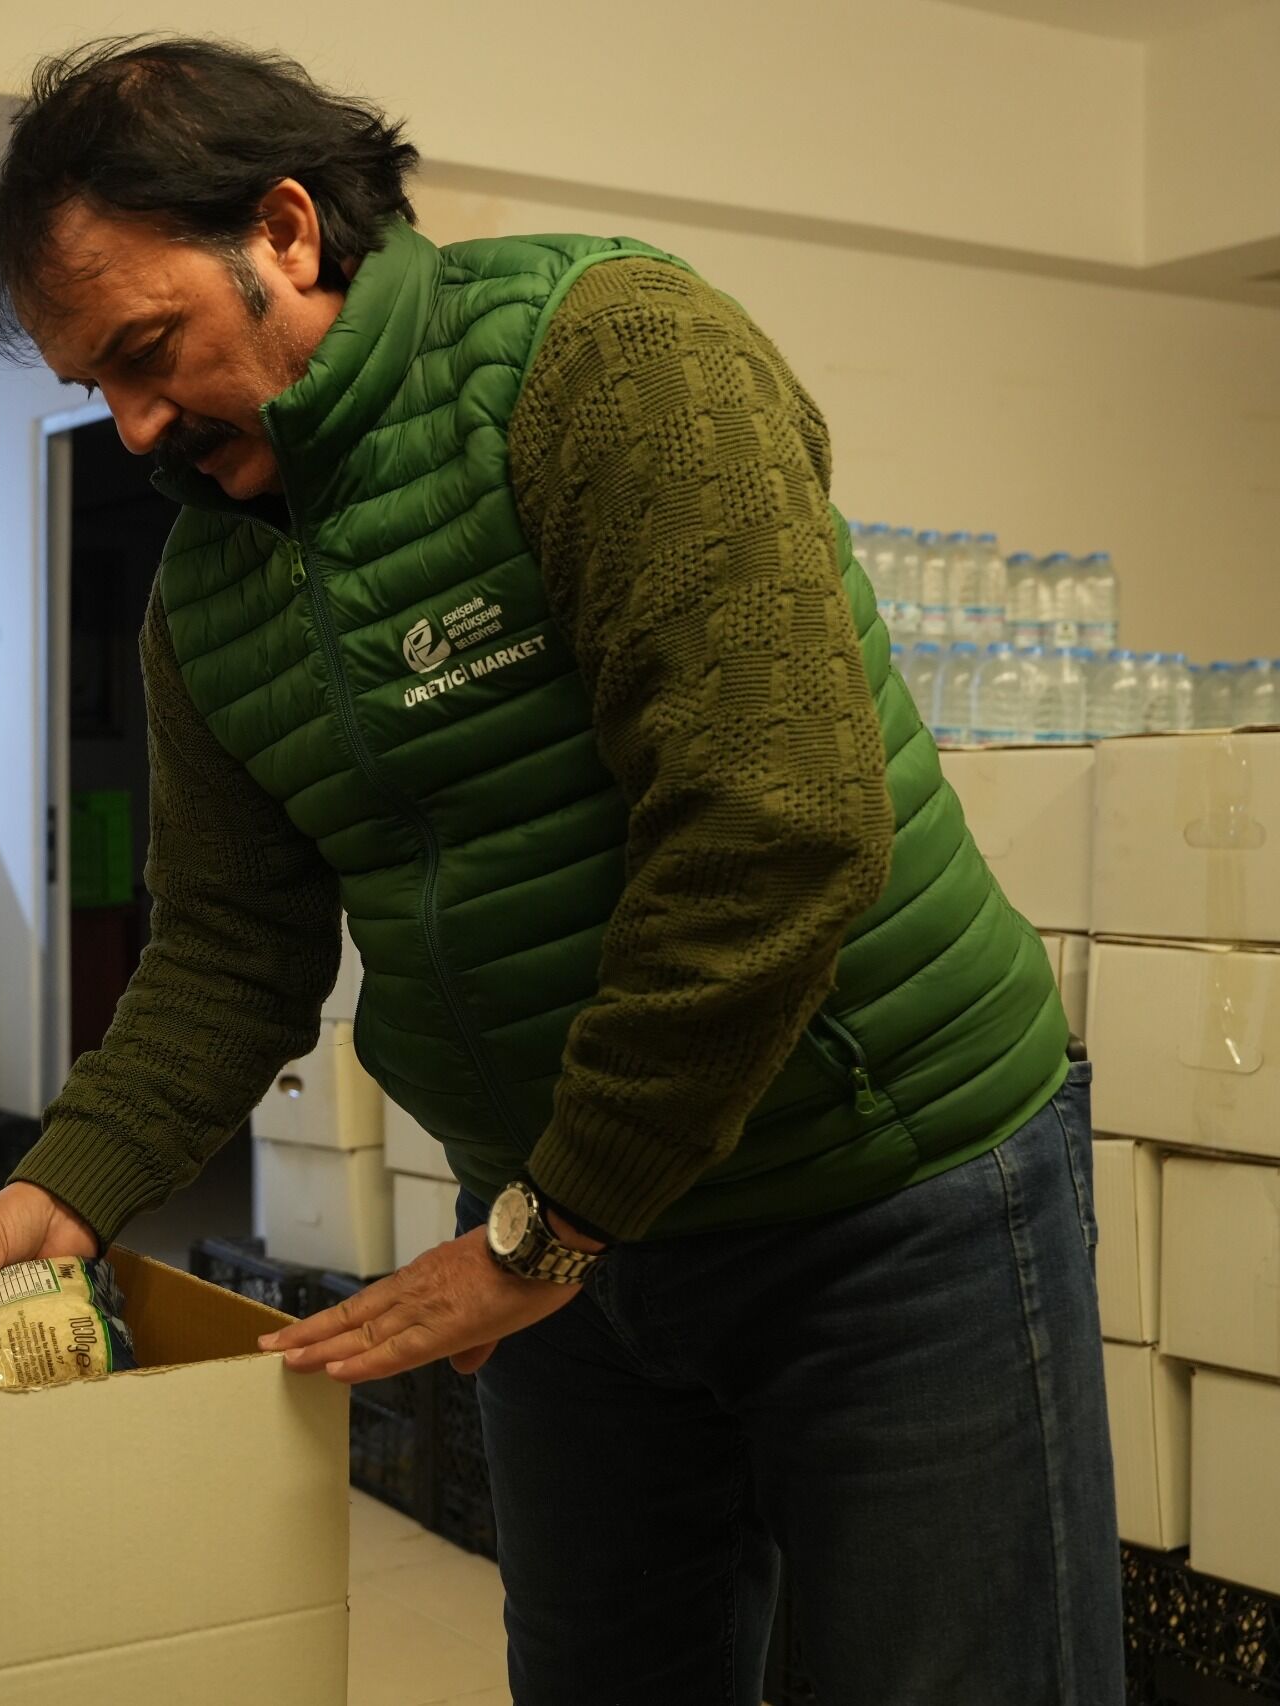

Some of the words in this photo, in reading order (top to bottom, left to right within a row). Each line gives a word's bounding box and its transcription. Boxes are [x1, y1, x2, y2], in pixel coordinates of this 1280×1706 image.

[441, 596, 486, 627] ESKİŞEHİR
[447, 604, 503, 640] BÜYÜKŞEHİR
[454, 619, 504, 651] BELEDİYESİ
[403, 663, 471, 708] ÜRETİCİ
[470, 634, 547, 679] MARKET
[55, 1355, 65, 1365] 97
